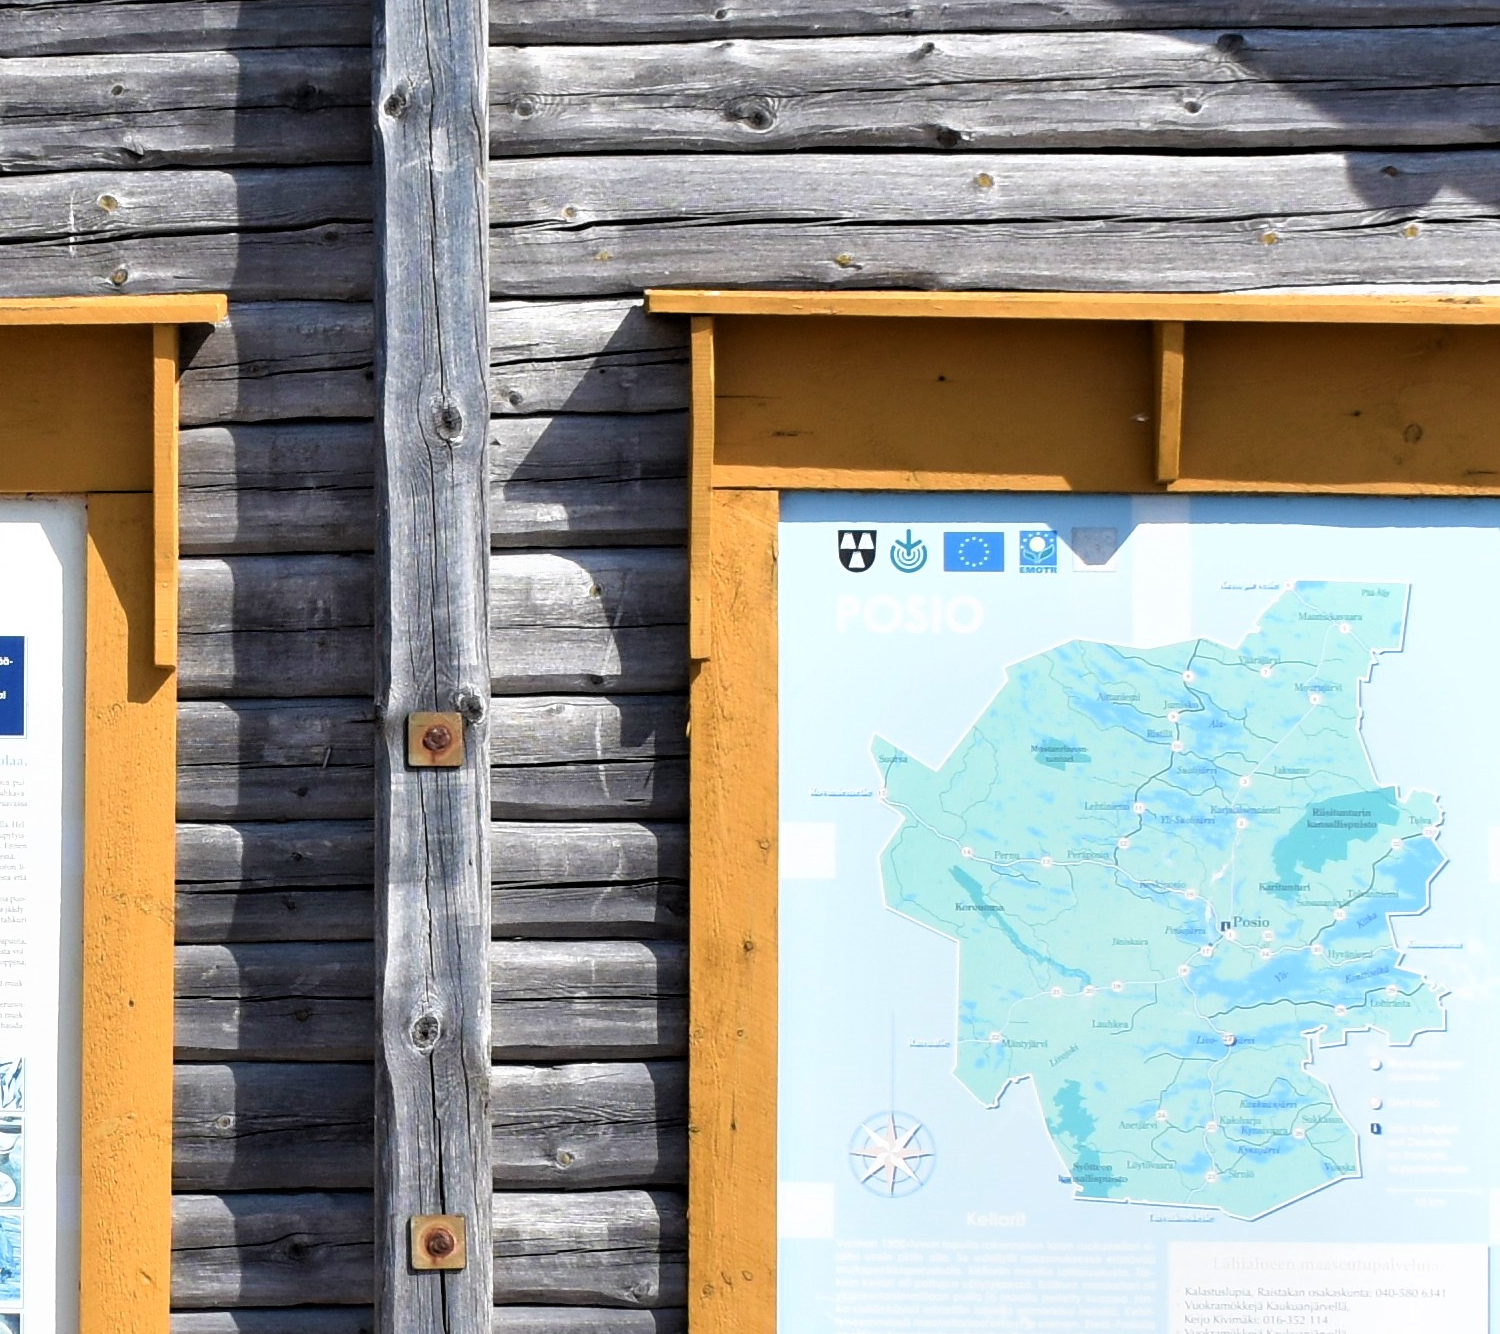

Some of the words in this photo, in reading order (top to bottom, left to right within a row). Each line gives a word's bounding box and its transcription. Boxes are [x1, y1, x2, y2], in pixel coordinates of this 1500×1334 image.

[1019, 565, 1058, 574] EMOTR
[836, 595, 984, 634] POSIO
[1233, 916, 1269, 927] Posio
